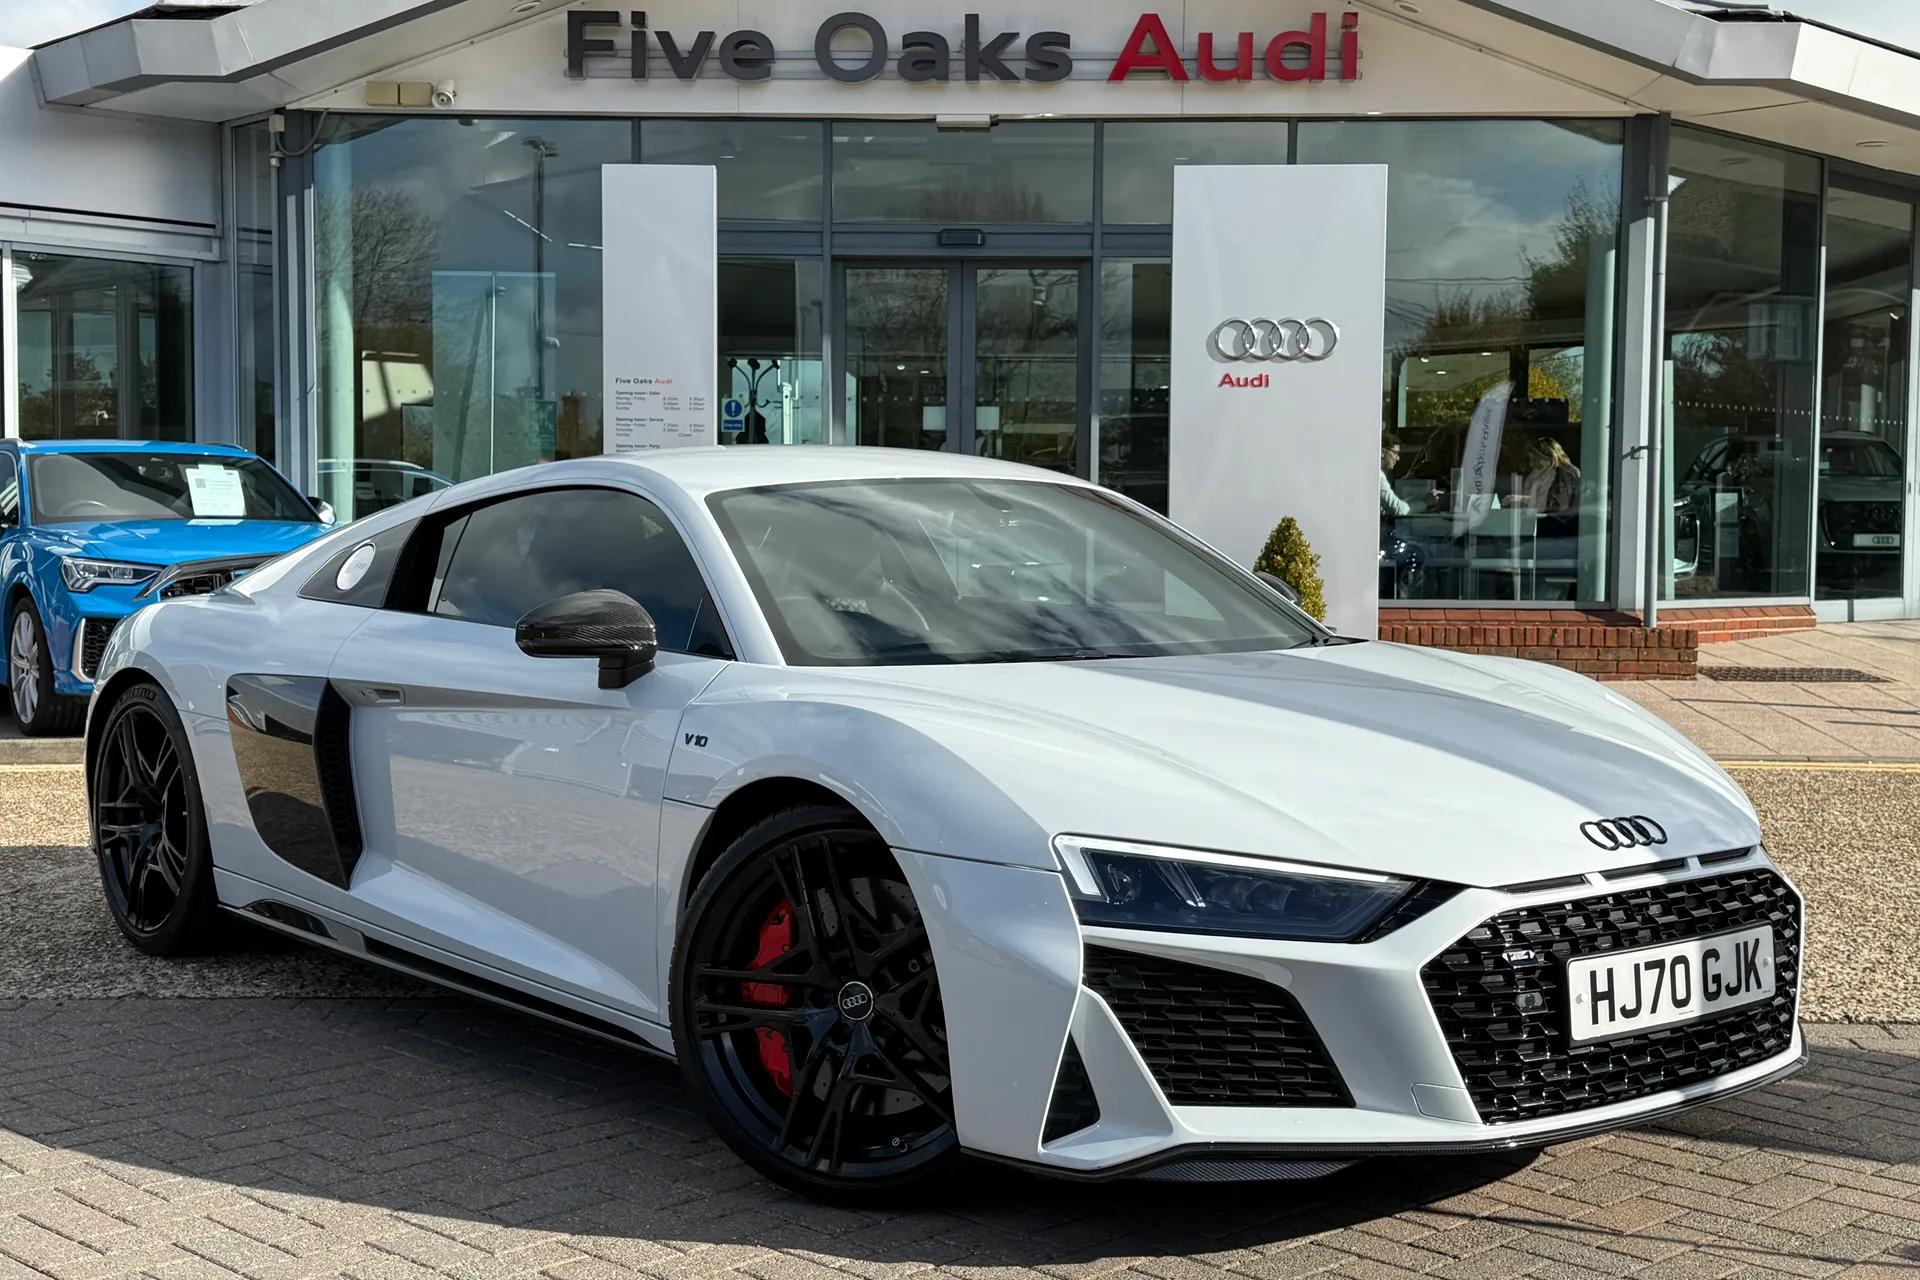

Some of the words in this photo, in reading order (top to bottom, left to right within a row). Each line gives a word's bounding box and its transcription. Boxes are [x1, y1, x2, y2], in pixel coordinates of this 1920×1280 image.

[568, 11, 775, 82] Five
[815, 12, 1073, 83] Oaks
[1107, 12, 1359, 83] Audi
[1217, 373, 1270, 388] Audi
[685, 732, 709, 748] V10
[1589, 954, 1691, 1025] HJ70
[1701, 938, 1763, 1002] GJK
